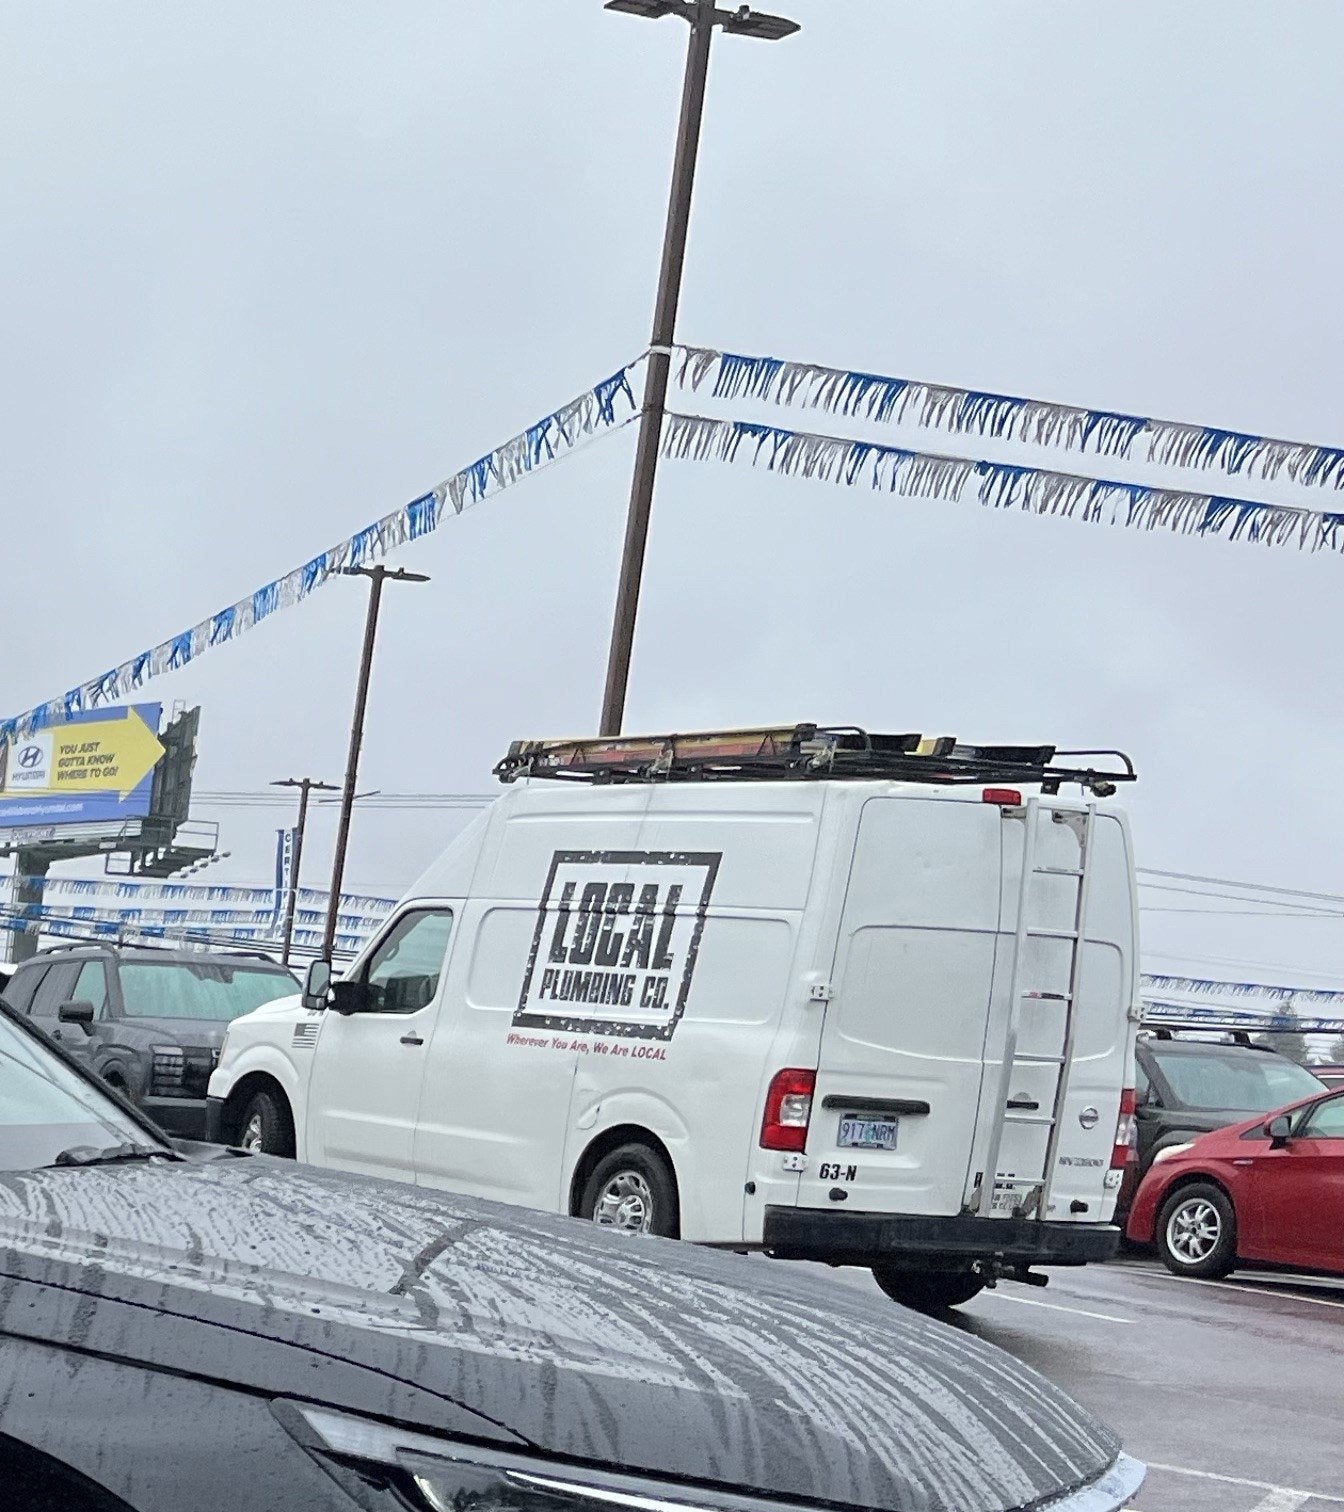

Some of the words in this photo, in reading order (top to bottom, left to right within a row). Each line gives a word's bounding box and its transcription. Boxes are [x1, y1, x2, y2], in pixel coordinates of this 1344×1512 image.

[60, 744, 79, 755] YOU
[79, 742, 101, 753] JUST
[58, 757, 85, 768] GOTTA
[87, 753, 116, 766] KNOW
[11, 770, 46, 781] HYUNDAI
[57, 768, 88, 781] WHERE
[90, 767, 101, 778] TO
[548, 881, 683, 970] LOCAL
[539, 968, 637, 1006] PLUMBING
[639, 976, 670, 1010] CO.
[506, 1032, 549, 1048] Wherever
[551, 1037, 568, 1050] You
[569, 1040, 590, 1055] Are,
[593, 1042, 609, 1055] We
[610, 1043, 629, 1057] Are
[631, 1045, 667, 1060] LOCAL
[842, 1122, 866, 1139] 917
[819, 1163, 858, 1181] 63-N
